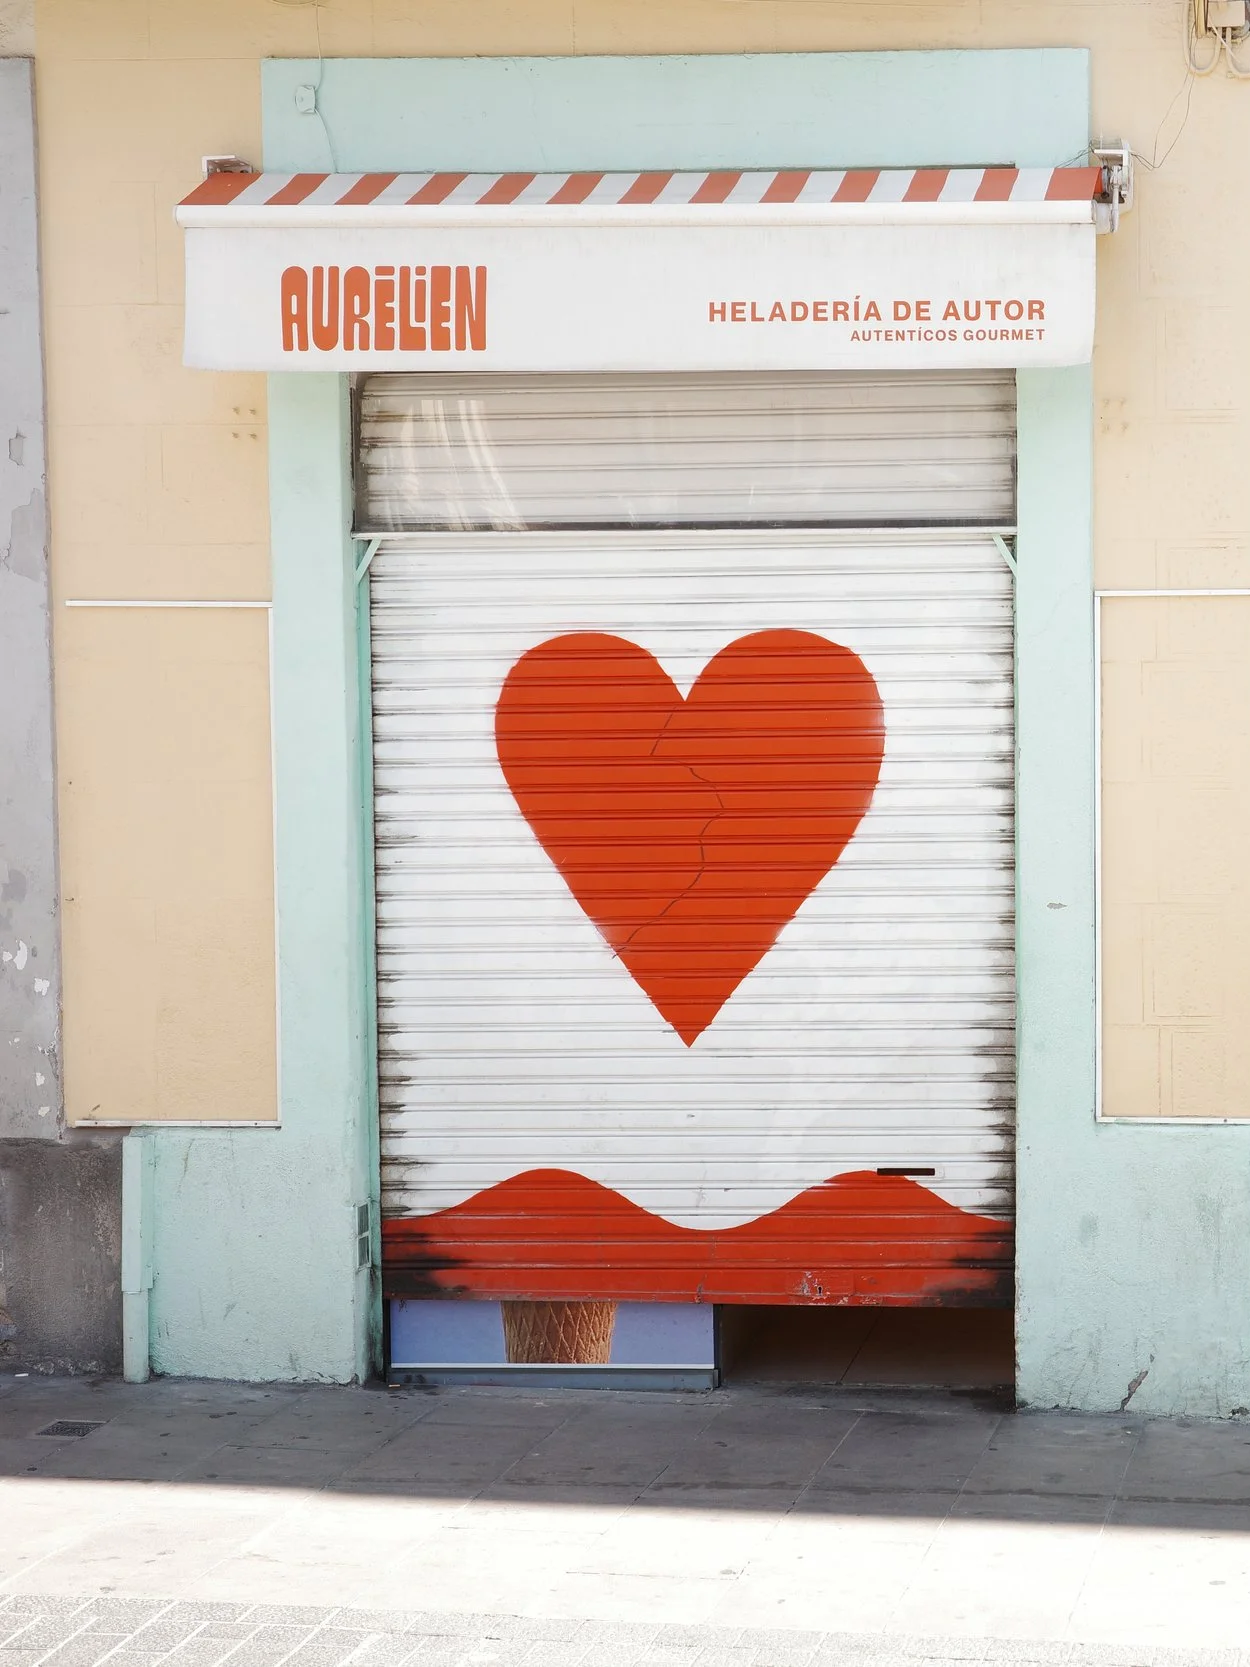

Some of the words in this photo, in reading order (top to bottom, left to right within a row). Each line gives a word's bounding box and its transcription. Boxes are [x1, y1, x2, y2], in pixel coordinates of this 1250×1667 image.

[709, 295, 882, 322] HELADERÍA
[893, 300, 931, 321] DE
[942, 299, 1045, 321] AUTOR
[850, 327, 958, 342] AUTENTÍCOS
[963, 328, 1045, 341] GOURMET
